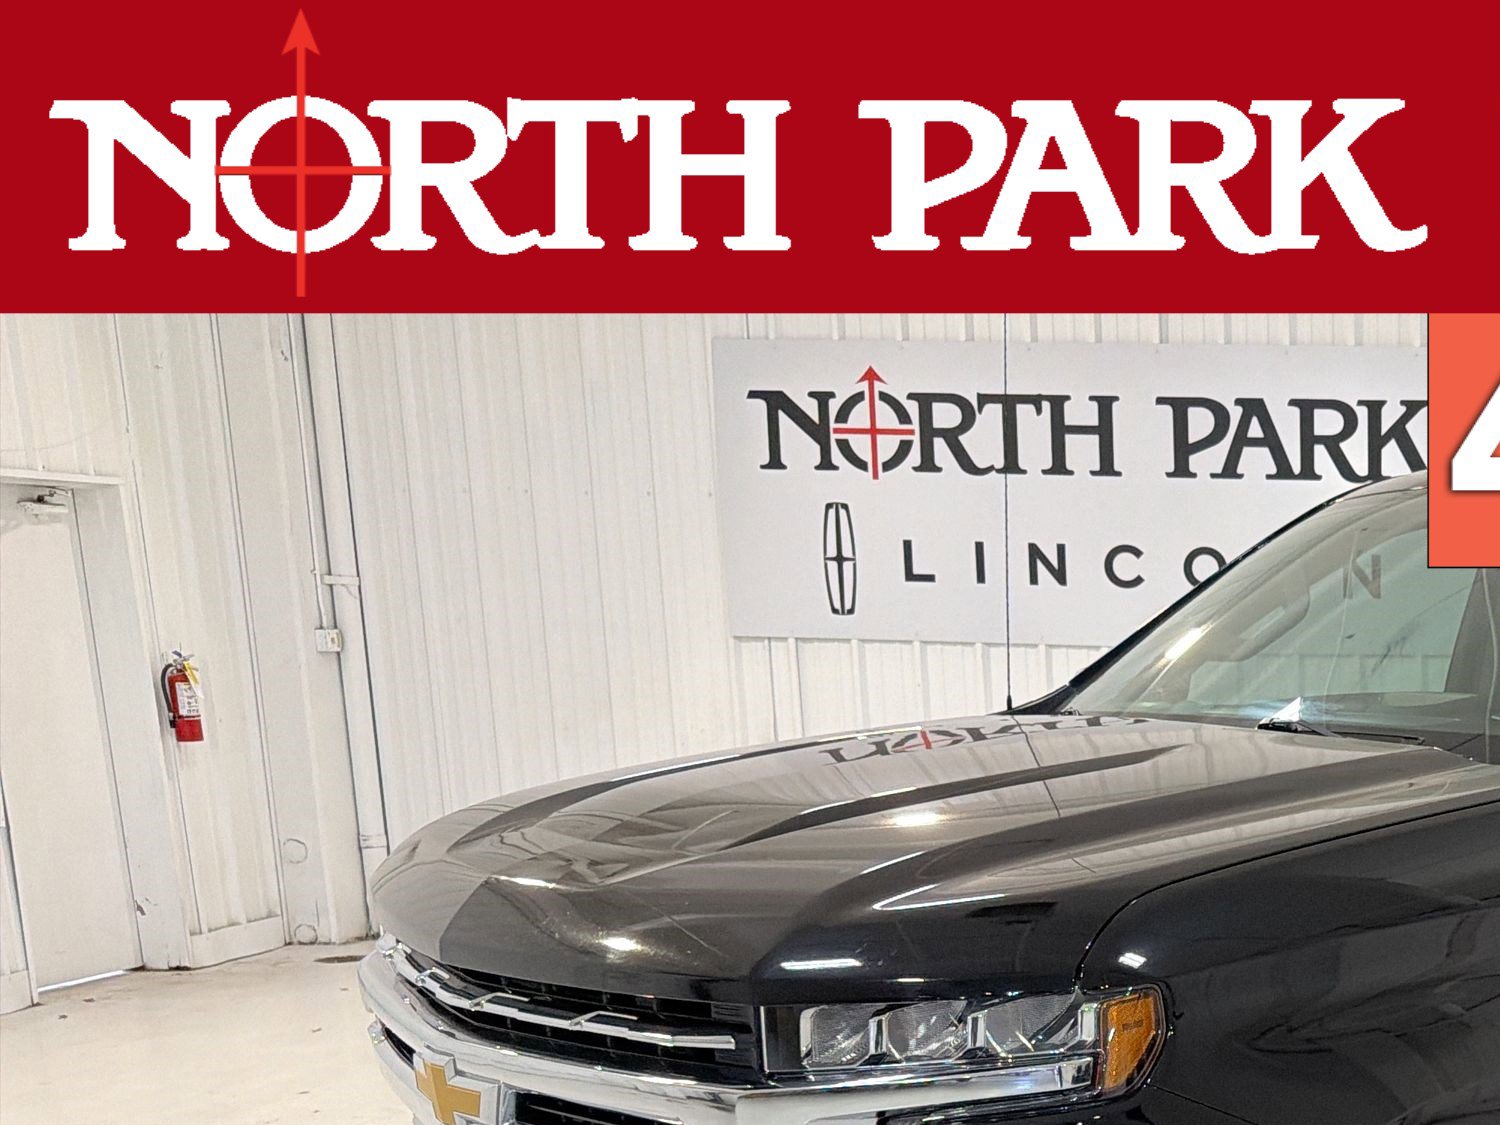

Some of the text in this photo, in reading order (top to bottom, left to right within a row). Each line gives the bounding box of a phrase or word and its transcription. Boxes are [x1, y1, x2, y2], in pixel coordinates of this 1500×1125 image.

[747, 390, 1427, 482] NORTH PARK
[903, 539, 1382, 600] LINCON
